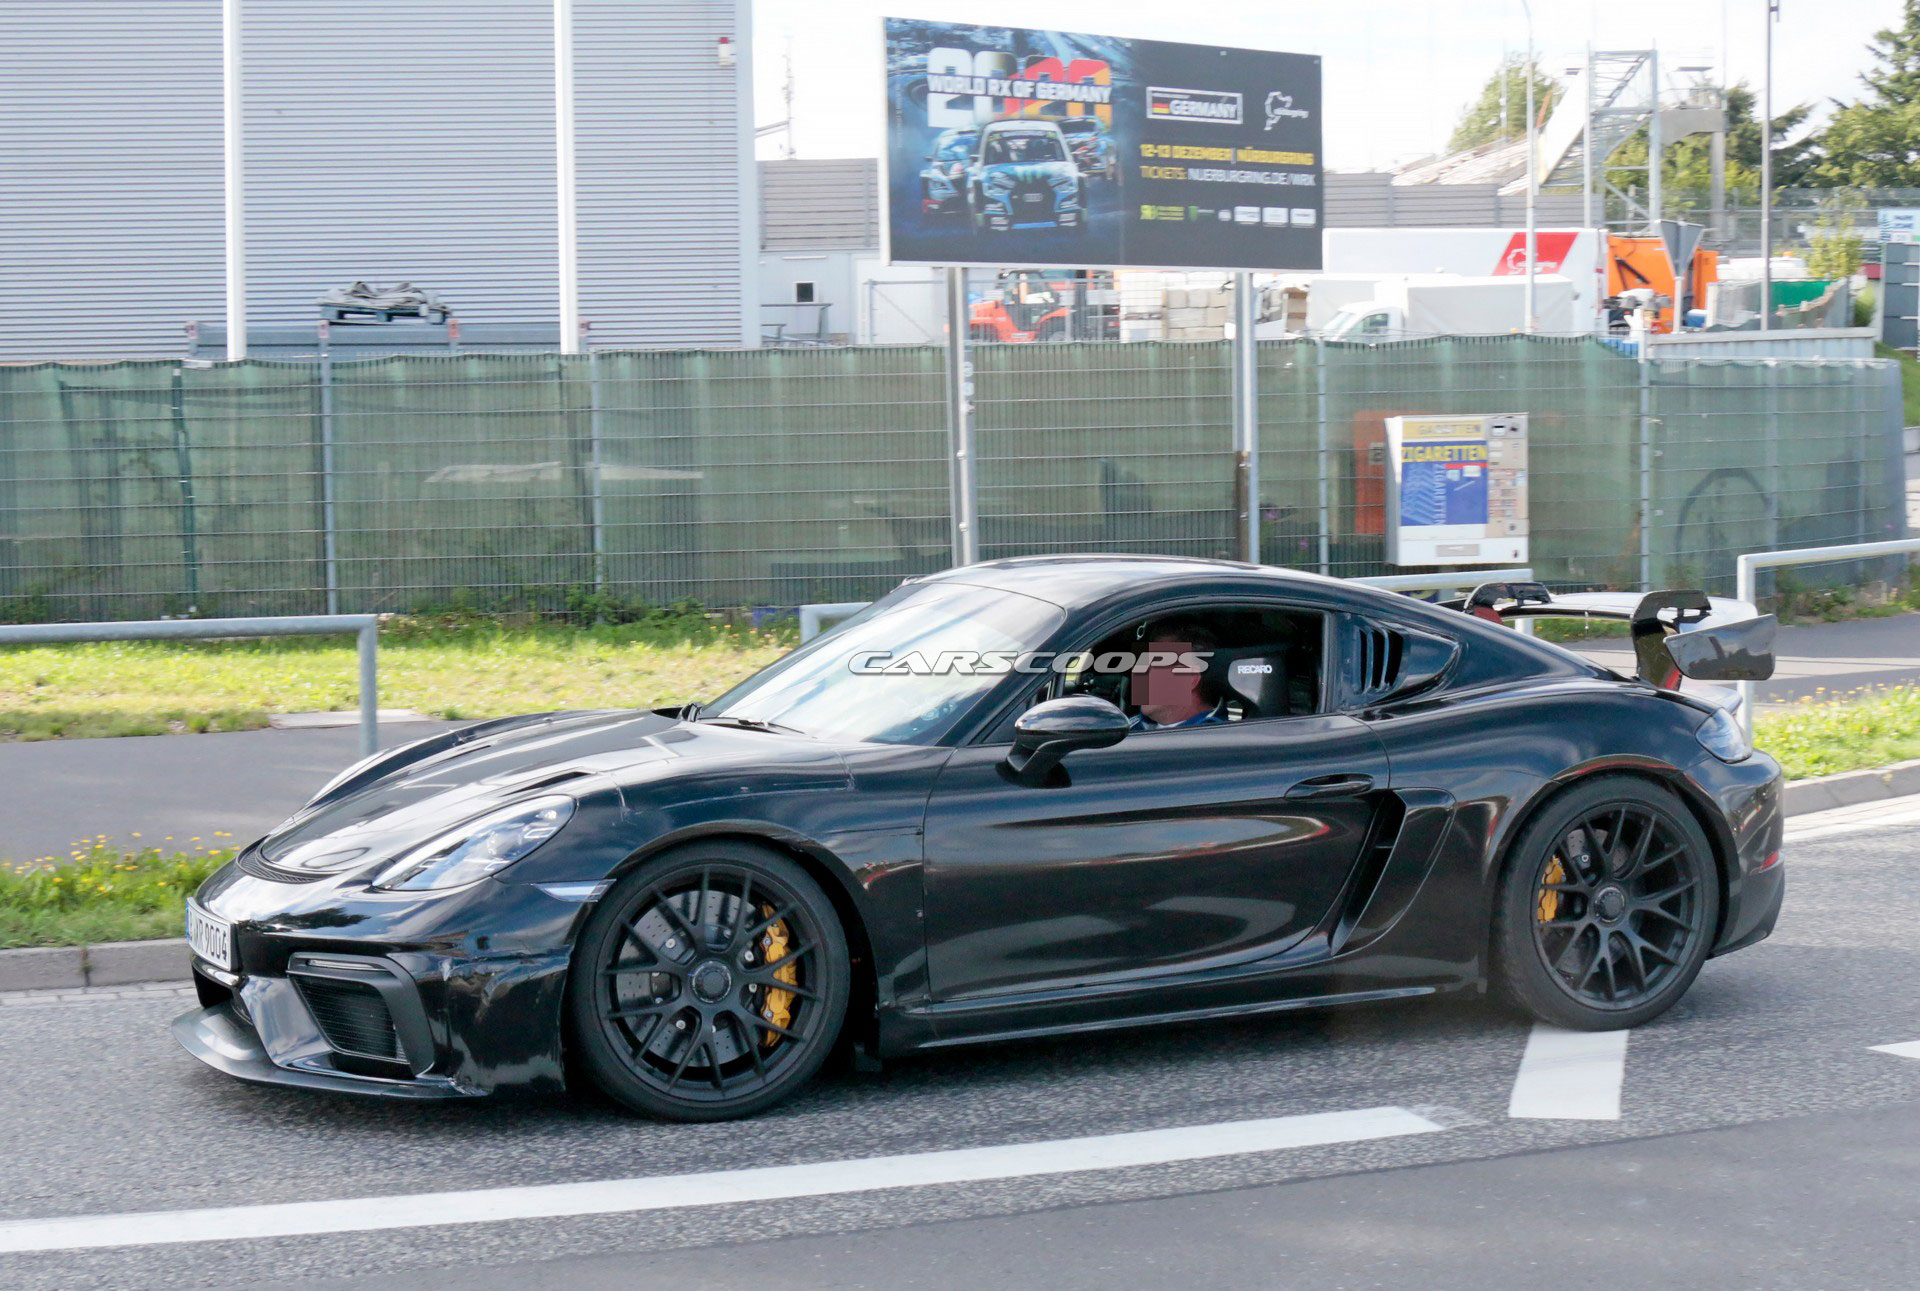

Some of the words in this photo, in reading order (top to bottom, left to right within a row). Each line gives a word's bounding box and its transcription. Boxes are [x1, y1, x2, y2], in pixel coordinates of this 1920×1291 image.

[928, 74, 986, 94] WORLD
[987, 79, 1012, 97] RX
[1013, 81, 1034, 98] OF
[1036, 82, 1112, 103] GERMANY
[1170, 99, 1237, 118] GERMANY
[1172, 145, 1231, 161] DEZEMBER
[1401, 445, 1487, 463] ZIGARETTEN
[1433, 463, 1447, 525] ZIGARETTEN
[1238, 665, 1273, 674] RECARO
[205, 923, 227, 962] 9004
